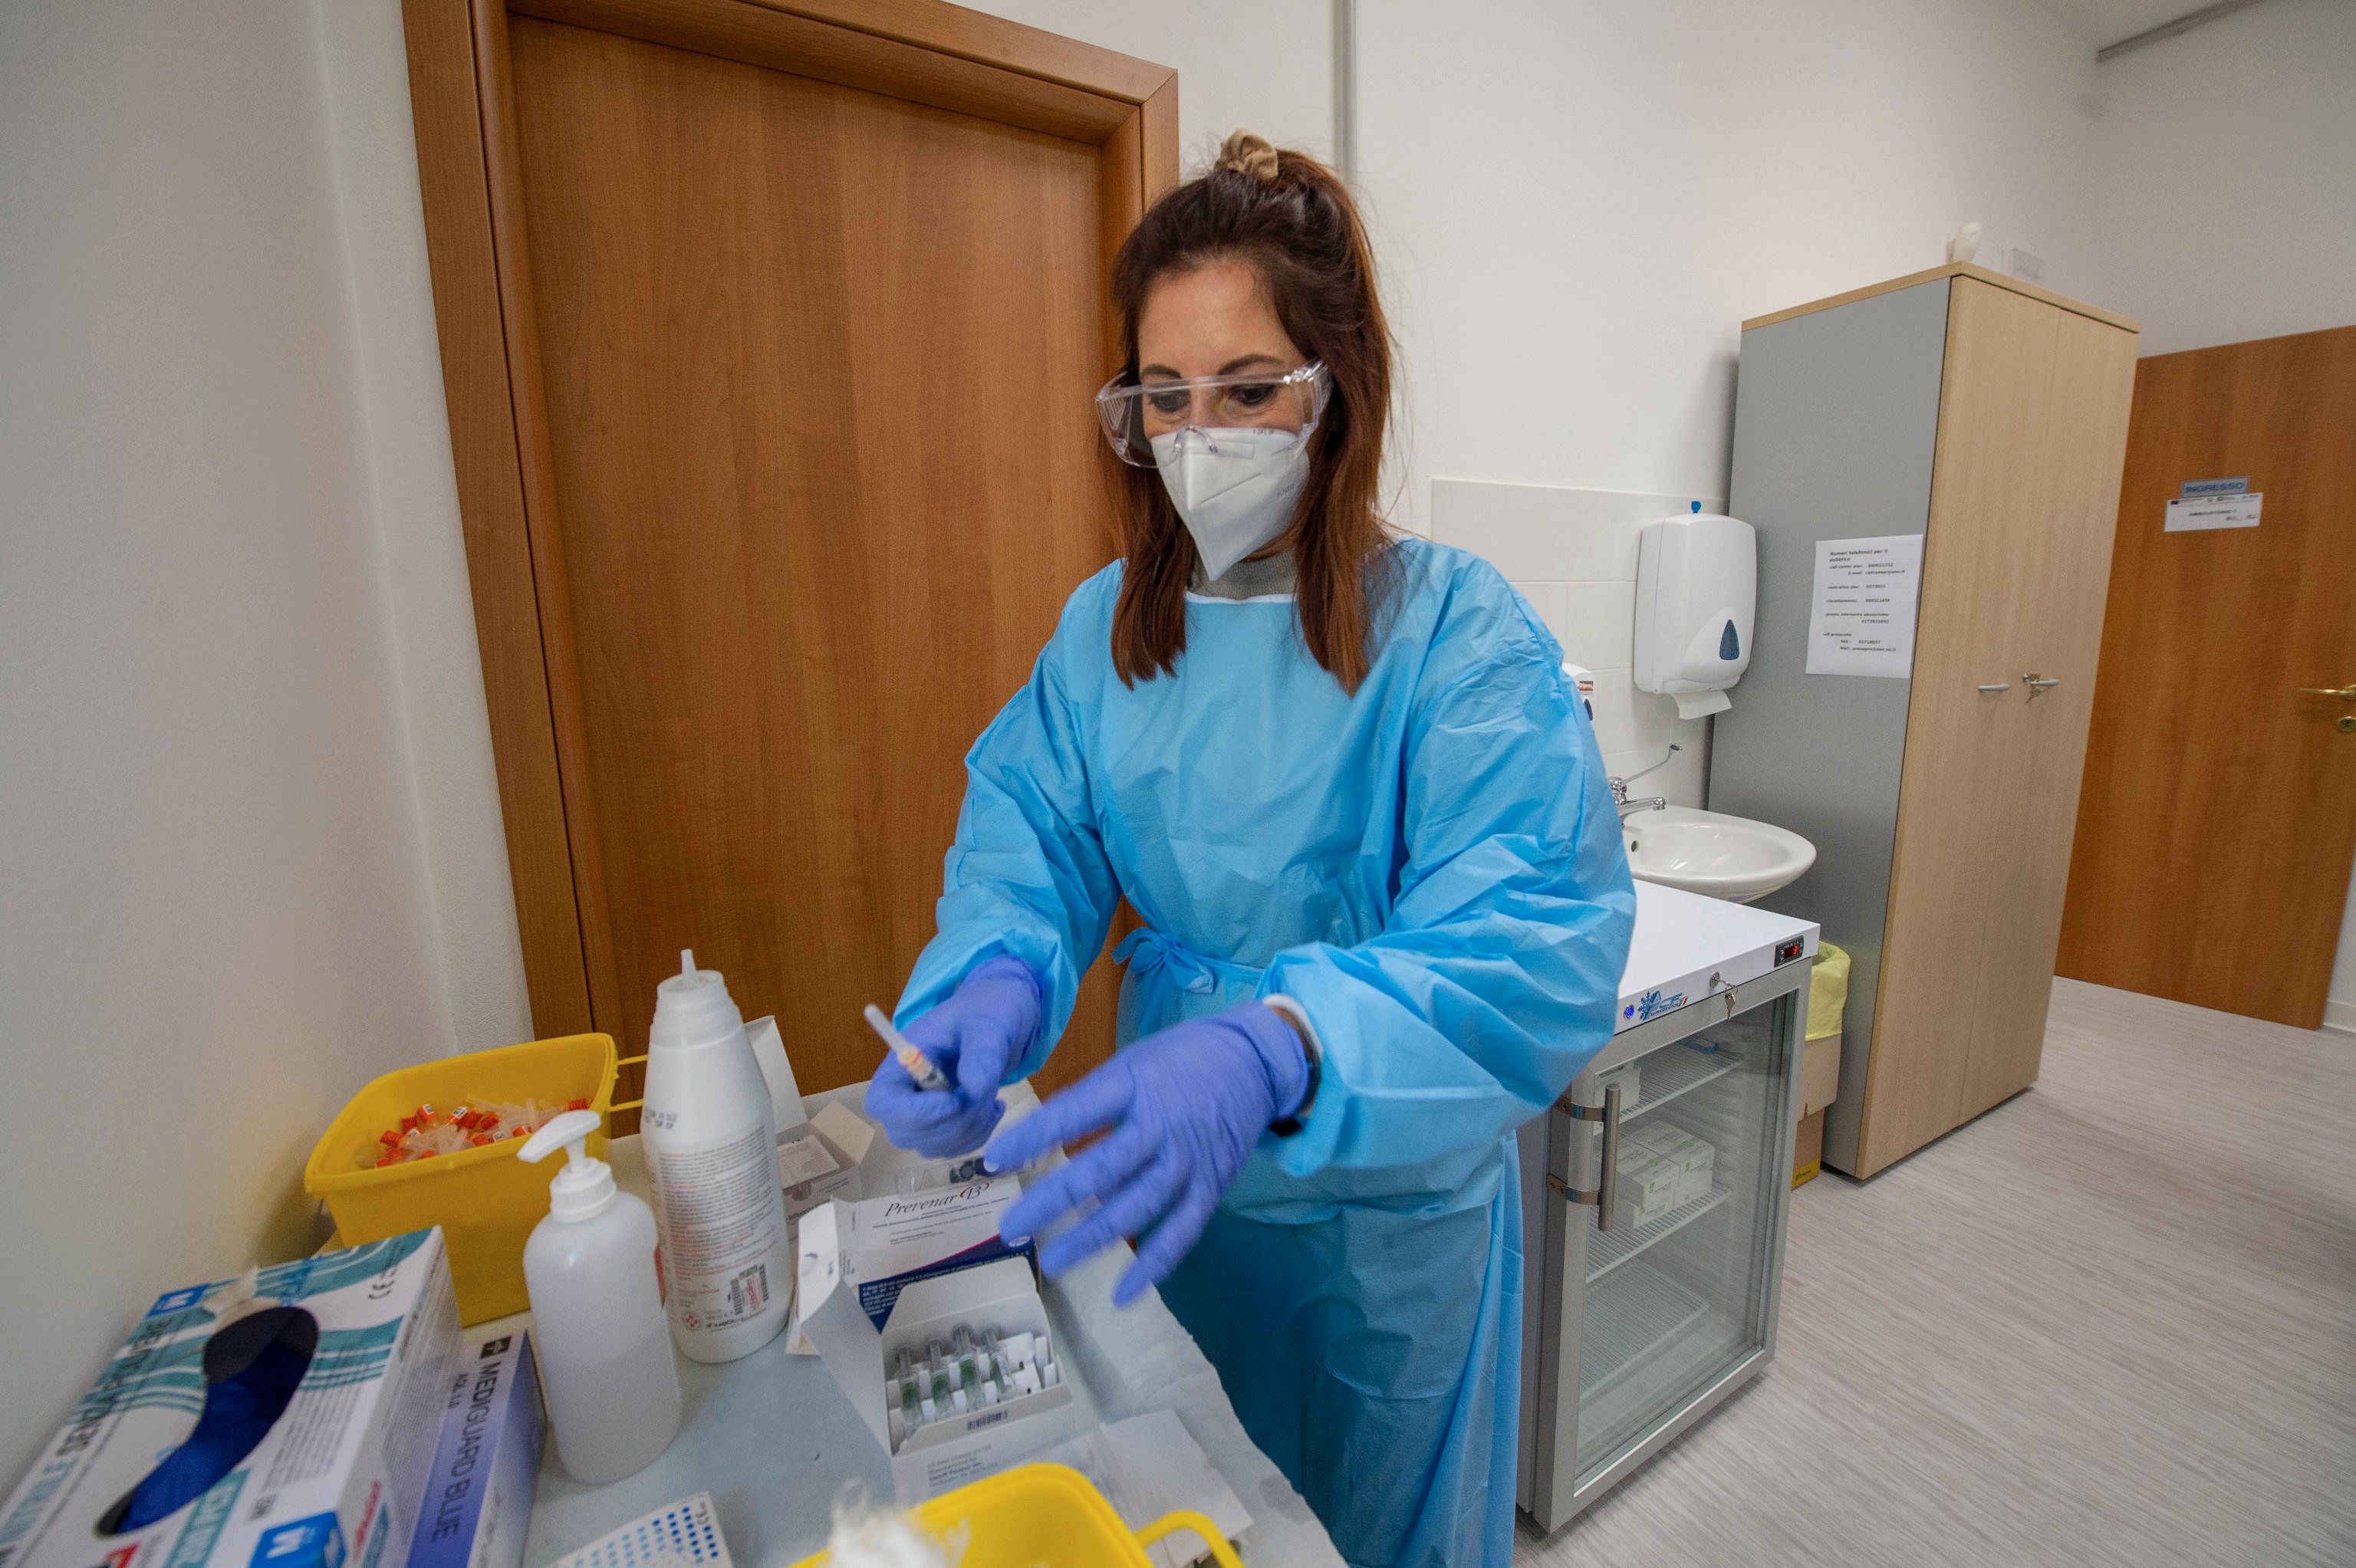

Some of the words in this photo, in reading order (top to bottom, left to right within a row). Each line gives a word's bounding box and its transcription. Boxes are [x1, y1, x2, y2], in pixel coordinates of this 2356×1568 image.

[2185, 482, 2245, 492] INGRESSO
[884, 1194, 958, 1217] Prevenar
[451, 1362, 501, 1478] MEDIGUARD
[432, 1478, 471, 1543] BLUE
